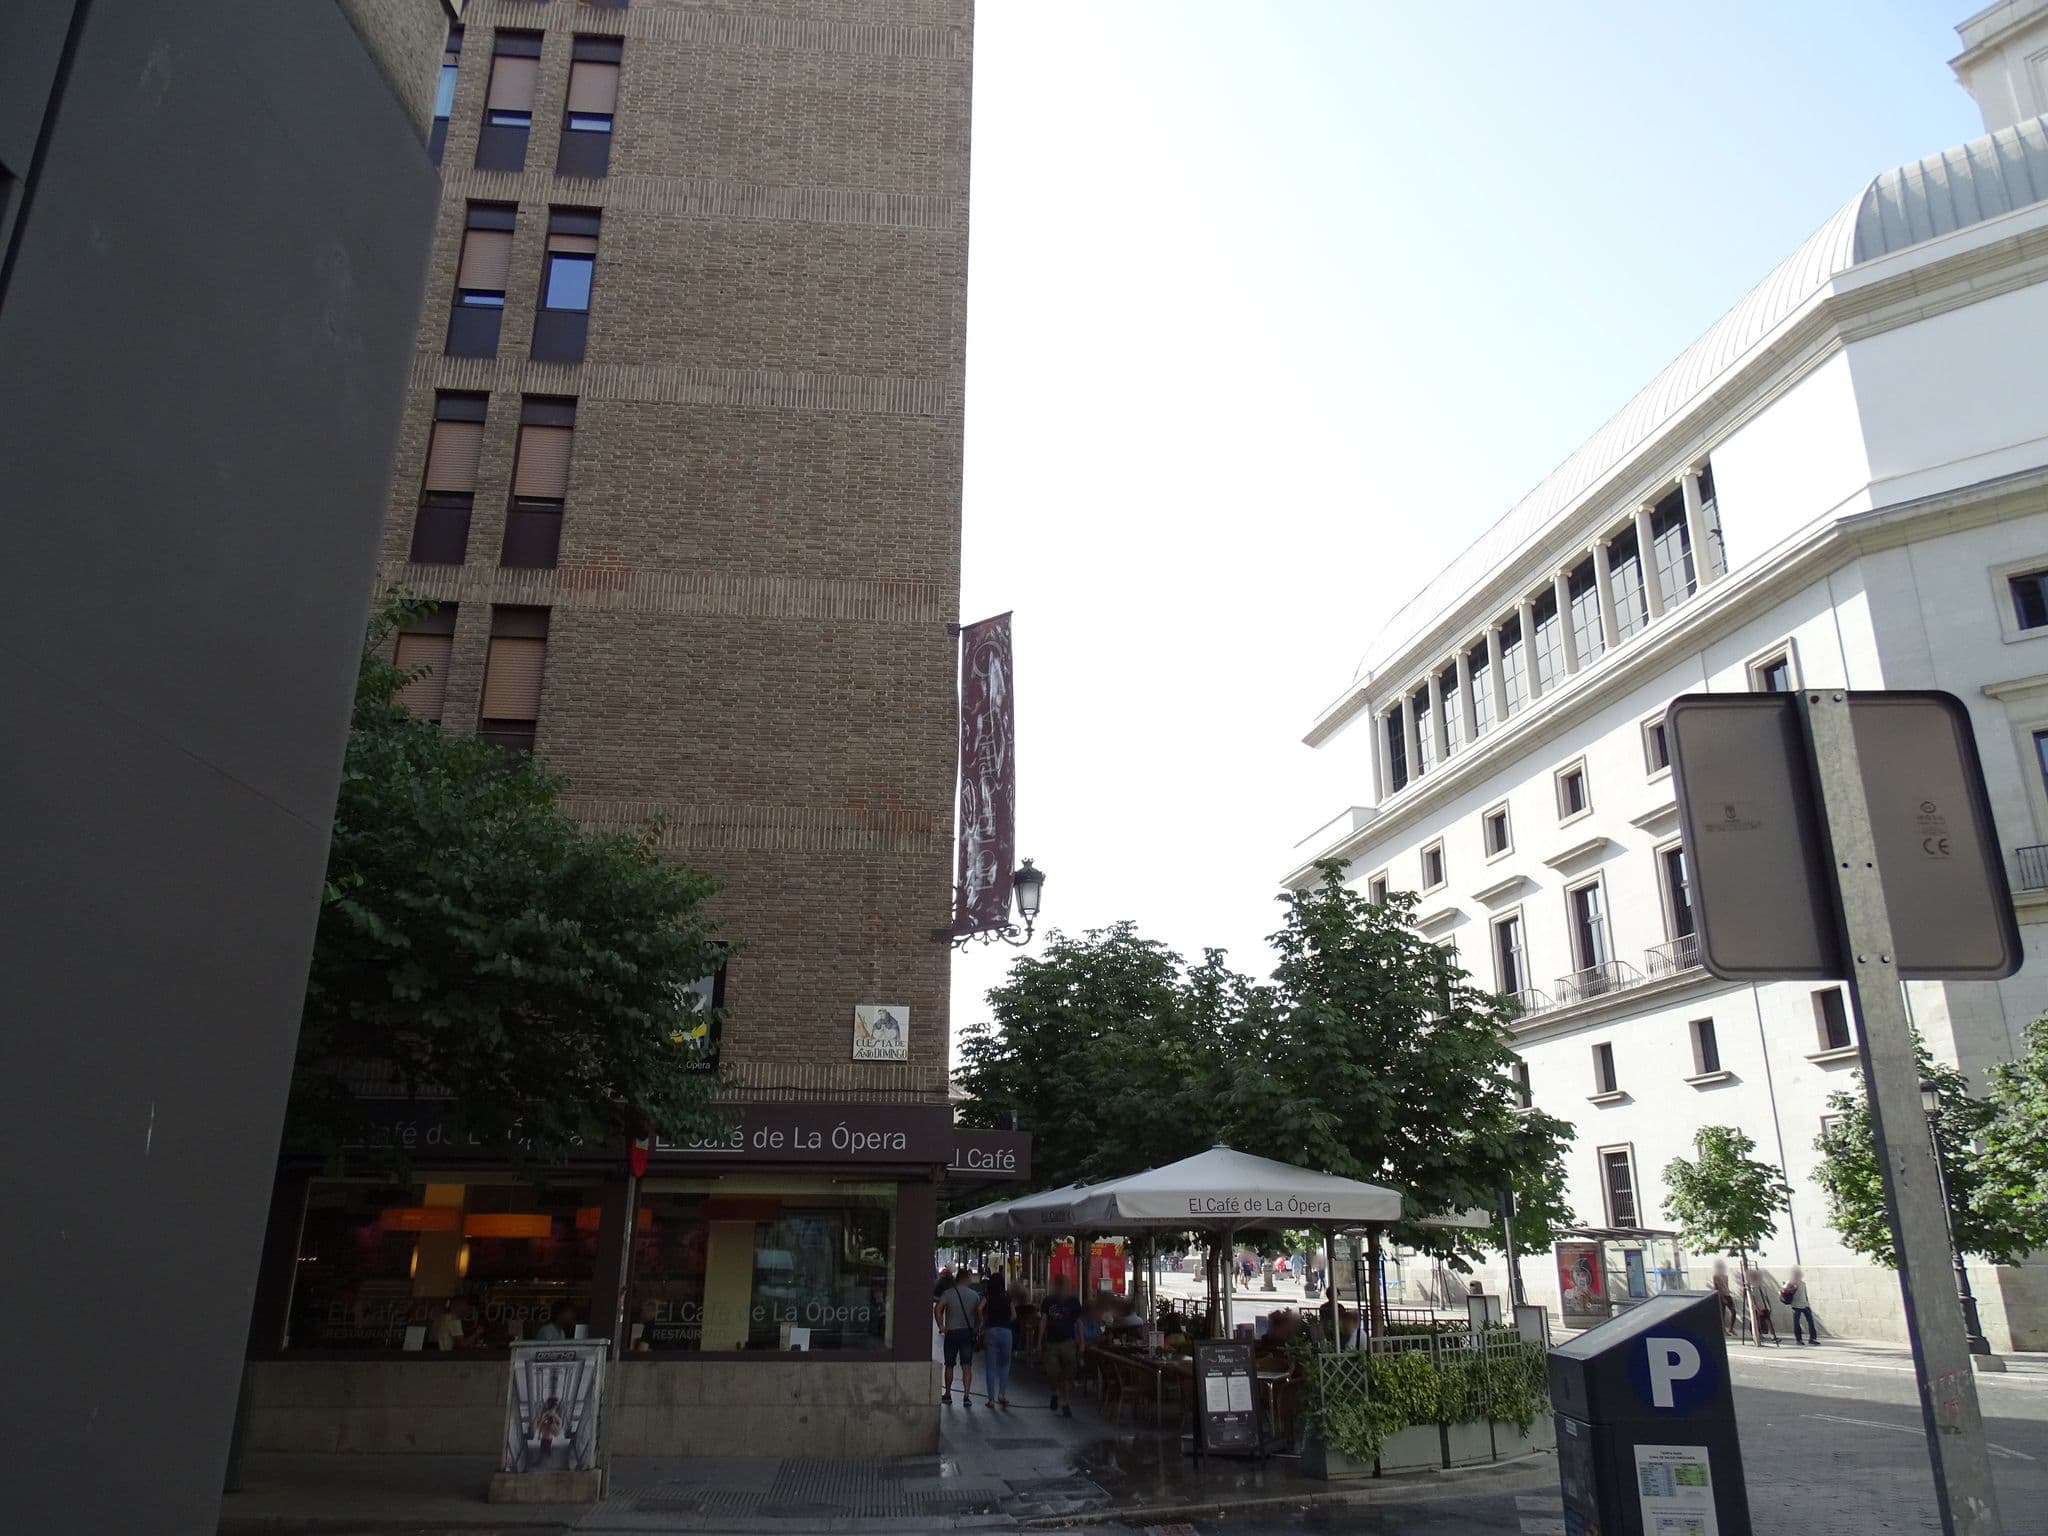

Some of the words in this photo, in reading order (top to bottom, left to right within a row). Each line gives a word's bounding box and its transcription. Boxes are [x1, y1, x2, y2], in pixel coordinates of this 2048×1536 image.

[1922, 837, 1950, 855] CE
[856, 1039, 893, 1049] CUESTA
[895, 1040, 905, 1048] DE
[874, 1047, 908, 1059] DOMINGO
[752, 1126, 784, 1149] de
[793, 1126, 822, 1149] La
[831, 1120, 907, 1155] Ópera
[967, 1147, 1016, 1169] Café
[1189, 1198, 1202, 1212] El
[1206, 1197, 1240, 1212] Café
[1244, 1198, 1262, 1212] de
[1266, 1198, 1283, 1211] La
[1288, 1195, 1331, 1214] Ópera
[655, 1301, 673, 1322] El
[773, 1301, 798, 1321] La
[806, 1296, 871, 1325] Ópera
[1645, 1338, 1701, 1408] P
